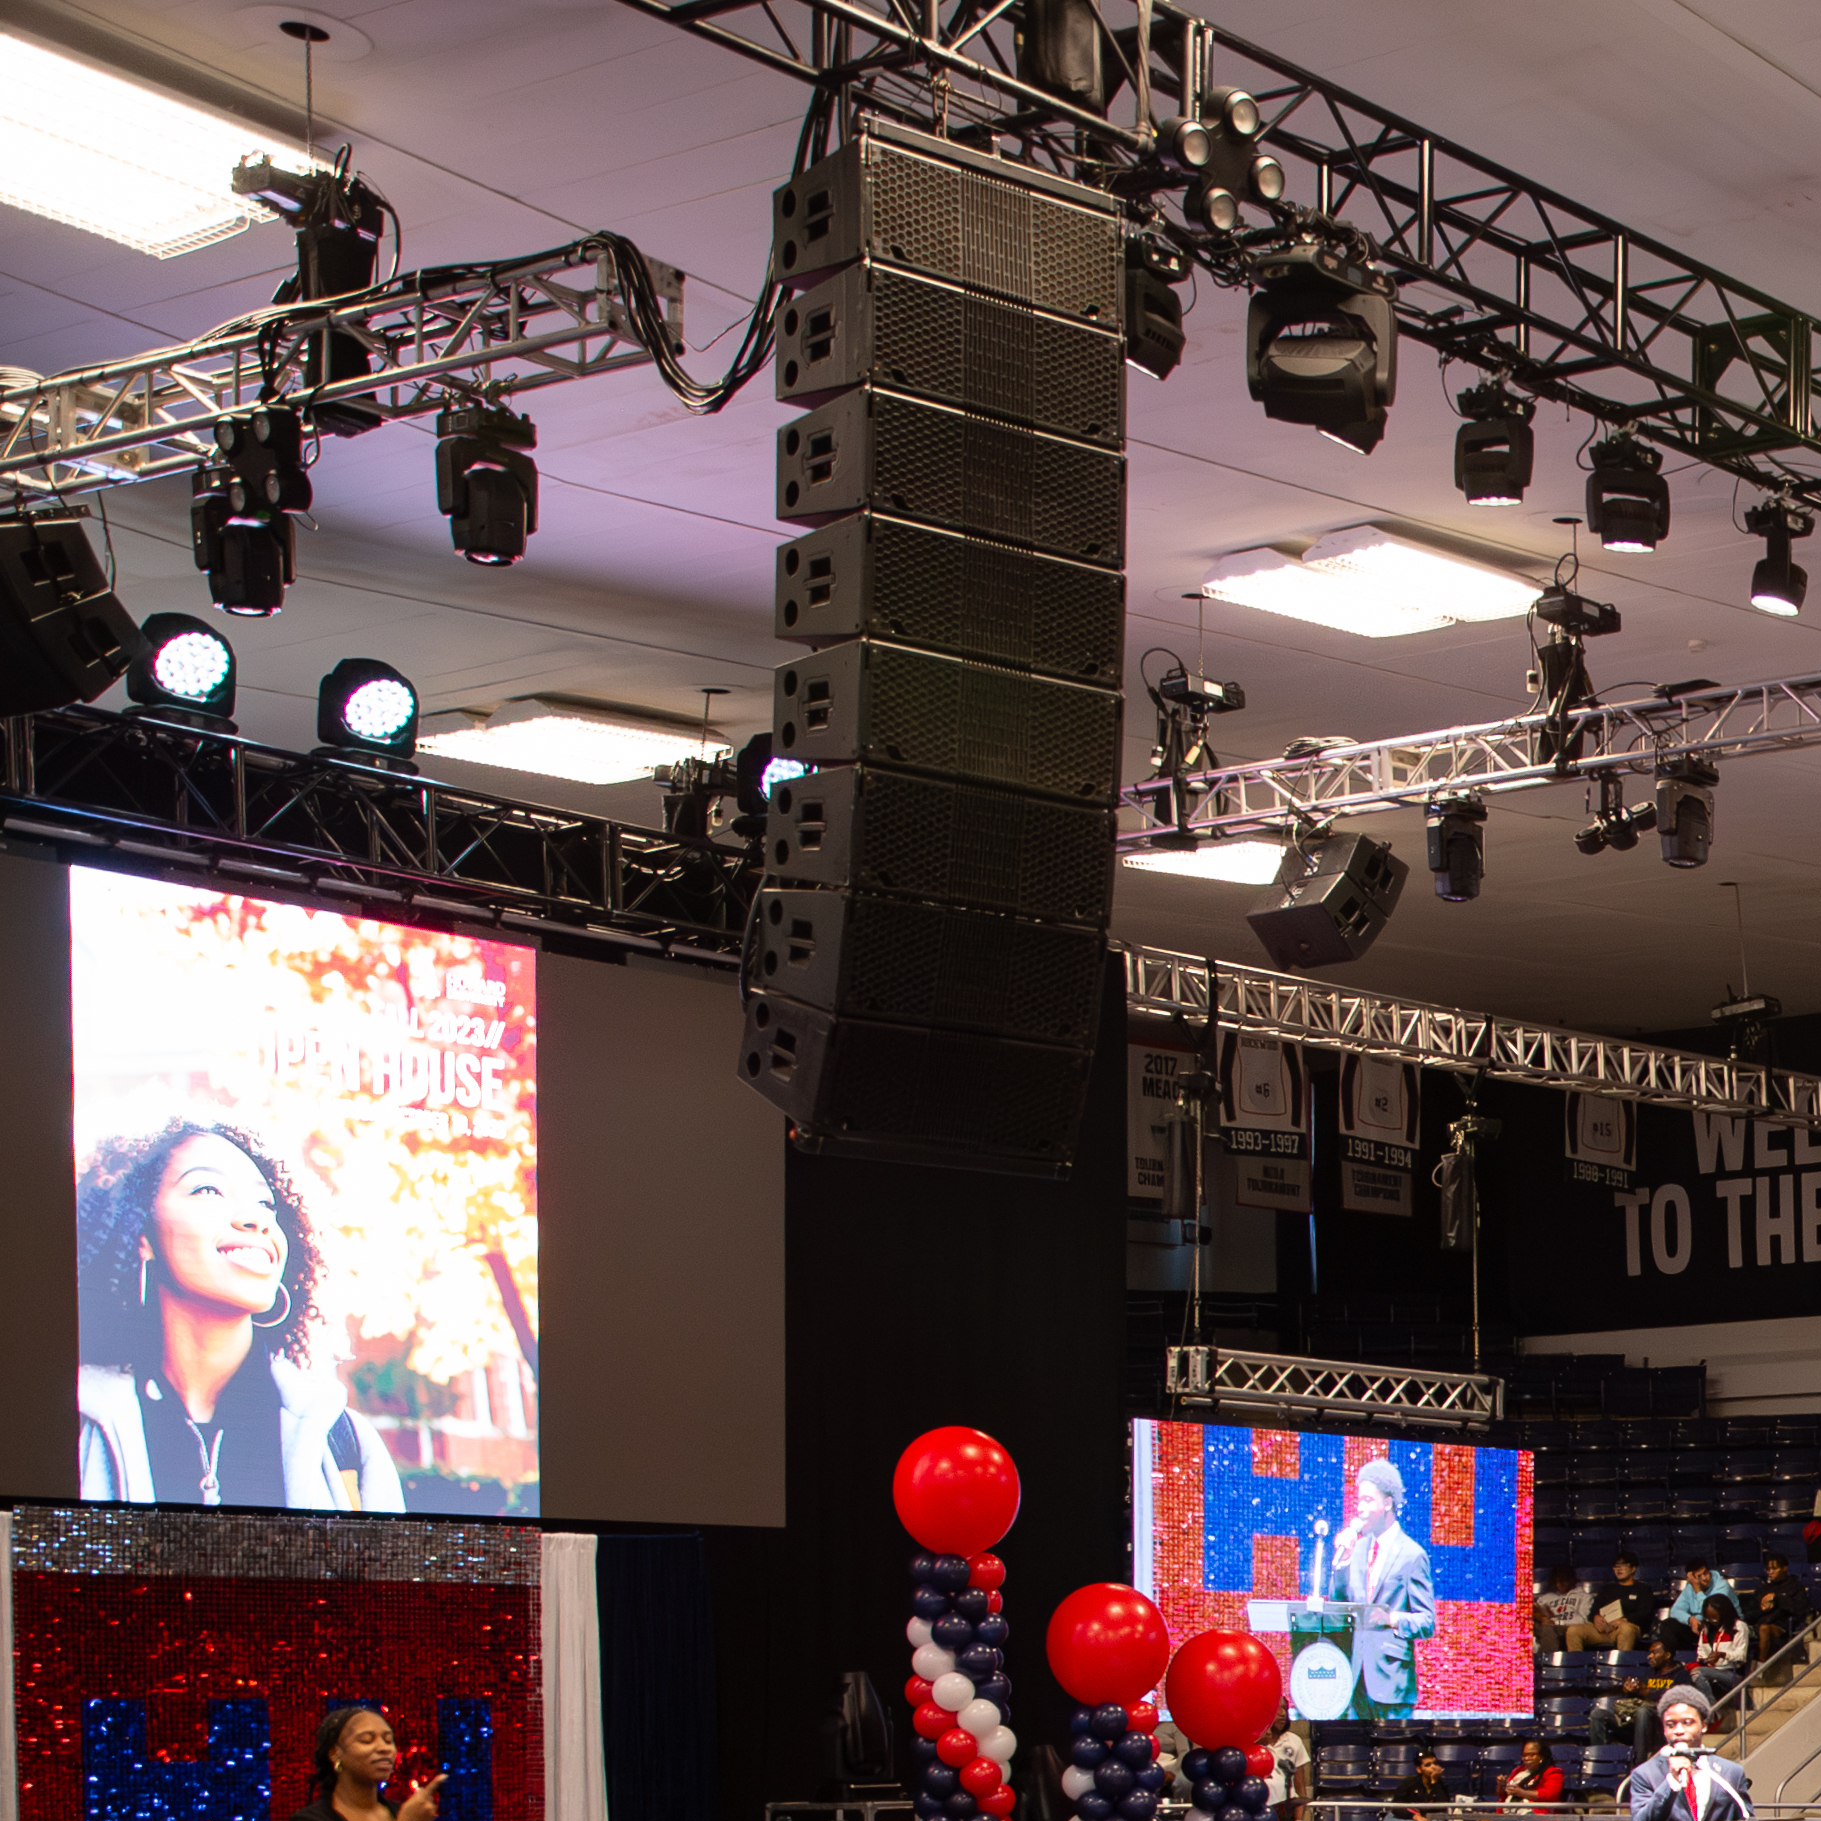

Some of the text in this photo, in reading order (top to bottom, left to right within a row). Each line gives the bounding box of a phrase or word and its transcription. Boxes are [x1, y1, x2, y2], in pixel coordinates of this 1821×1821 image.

[1143, 1053, 1178, 1075] 2017
[371, 1048, 506, 1112] HOUSE
[1231, 1130, 1300, 1156] 1993-1997
[1346, 1138, 1413, 1169] 1991-1994
[1134, 1156, 1164, 1172] TOURN
[1613, 1182, 1693, 1277] TO
